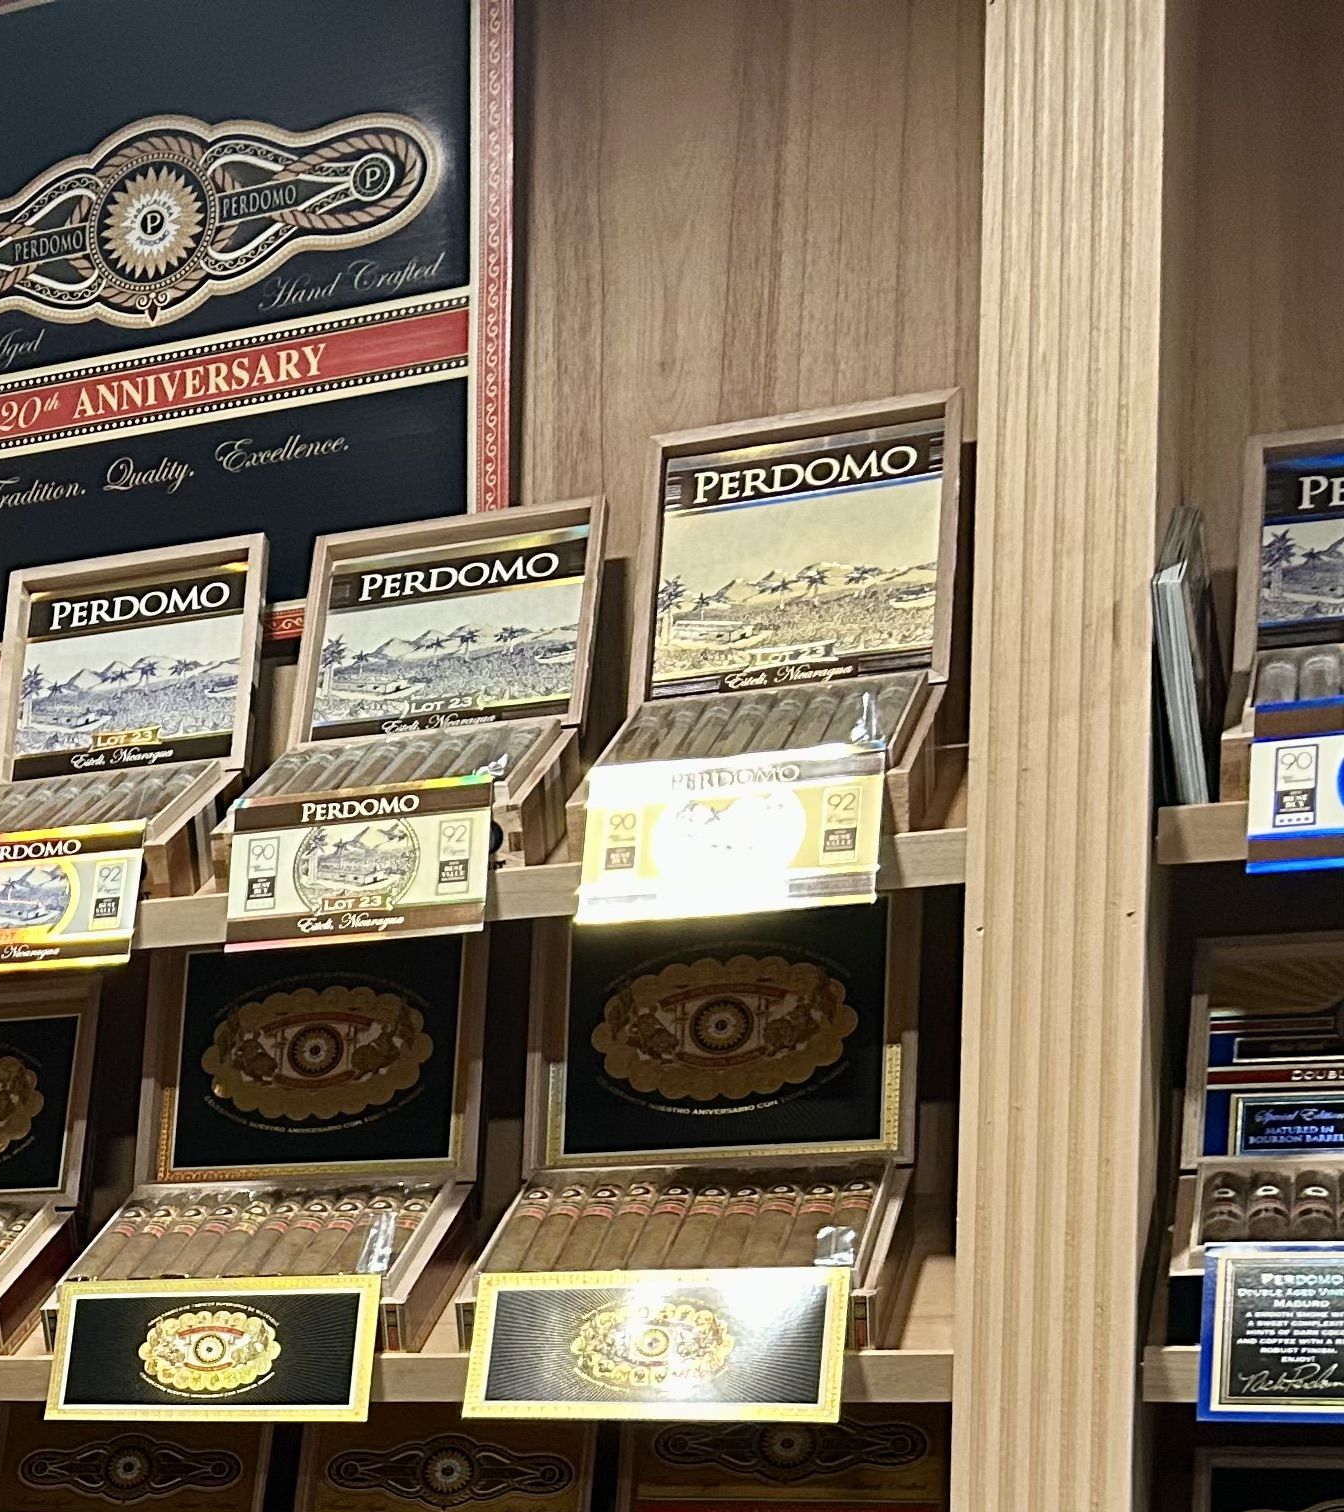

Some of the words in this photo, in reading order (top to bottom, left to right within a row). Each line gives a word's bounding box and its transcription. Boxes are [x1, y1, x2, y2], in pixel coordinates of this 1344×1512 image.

[364, 166, 381, 189] P
[221, 185, 298, 218] PERDOMO
[144, 211, 162, 235] P
[14, 229, 86, 262] PERDOMO
[257, 278, 337, 310] Hand
[346, 257, 445, 292] Crafted
[72, 343, 328, 418] ANNIVERSARY
[103, 457, 196, 494] Quality.
[214, 434, 350, 473] Excellence.
[692, 444, 919, 505] PERDOMO
[357, 552, 559, 602] PERDOMO
[49, 581, 231, 631] PERDOMO
[410, 699, 441, 715] LOT
[443, 695, 473, 711] 23
[1279, 751, 1312, 771] 90
[300, 793, 420, 822] PERDOMO
[441, 822, 467, 844] 92
[1237, 1288, 1284, 1297] DOUBLE
[1284, 1288, 1316, 1297] AGED
[1261, 1273, 1344, 1286] PERDOMO
[1273, 1299, 1330, 1308] MADURO
